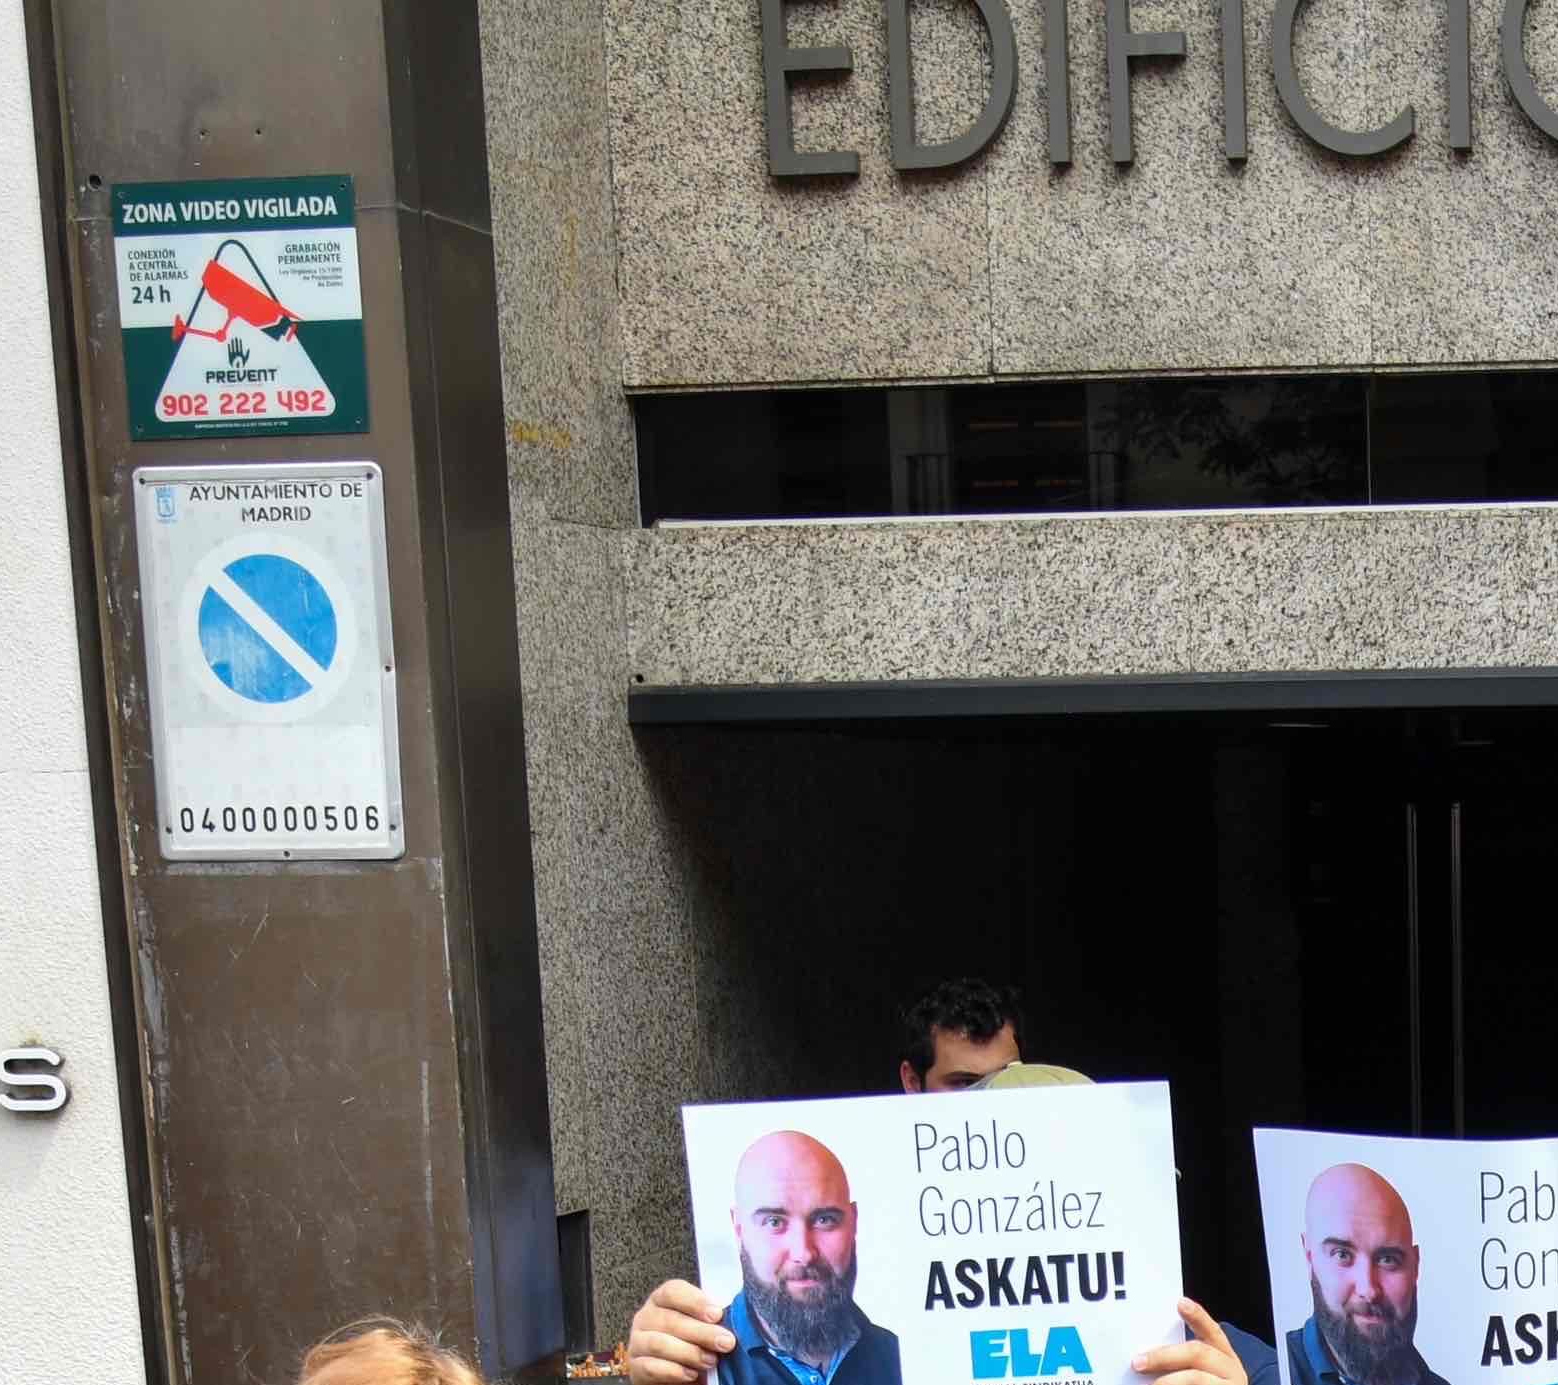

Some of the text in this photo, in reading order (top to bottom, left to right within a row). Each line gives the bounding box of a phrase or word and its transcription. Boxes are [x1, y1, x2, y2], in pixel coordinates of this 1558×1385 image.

[121, 196, 338, 224] ZONA VIDEO VIGILADA
[128, 248, 176, 260] CONEXIÓN
[278, 254, 342, 265] PERMANENTE
[129, 260, 179, 271] A CENTRAL
[130, 270, 189, 282] DE ALARMAS
[132, 285, 171, 304] 24 h
[206, 369, 278, 384] PREVENT
[162, 389, 326, 416] 902 222 492
[189, 483, 363, 503] AYUNTAMIENTO DE
[241, 506, 312, 522] MADRID
[179, 805, 380, 833] 0400000506
[914, 1119, 1027, 1173] Pablo
[918, 1180, 1106, 1238] González
[924, 1250, 1128, 1311] ASKATU!
[969, 1325, 1093, 1381] ELA
